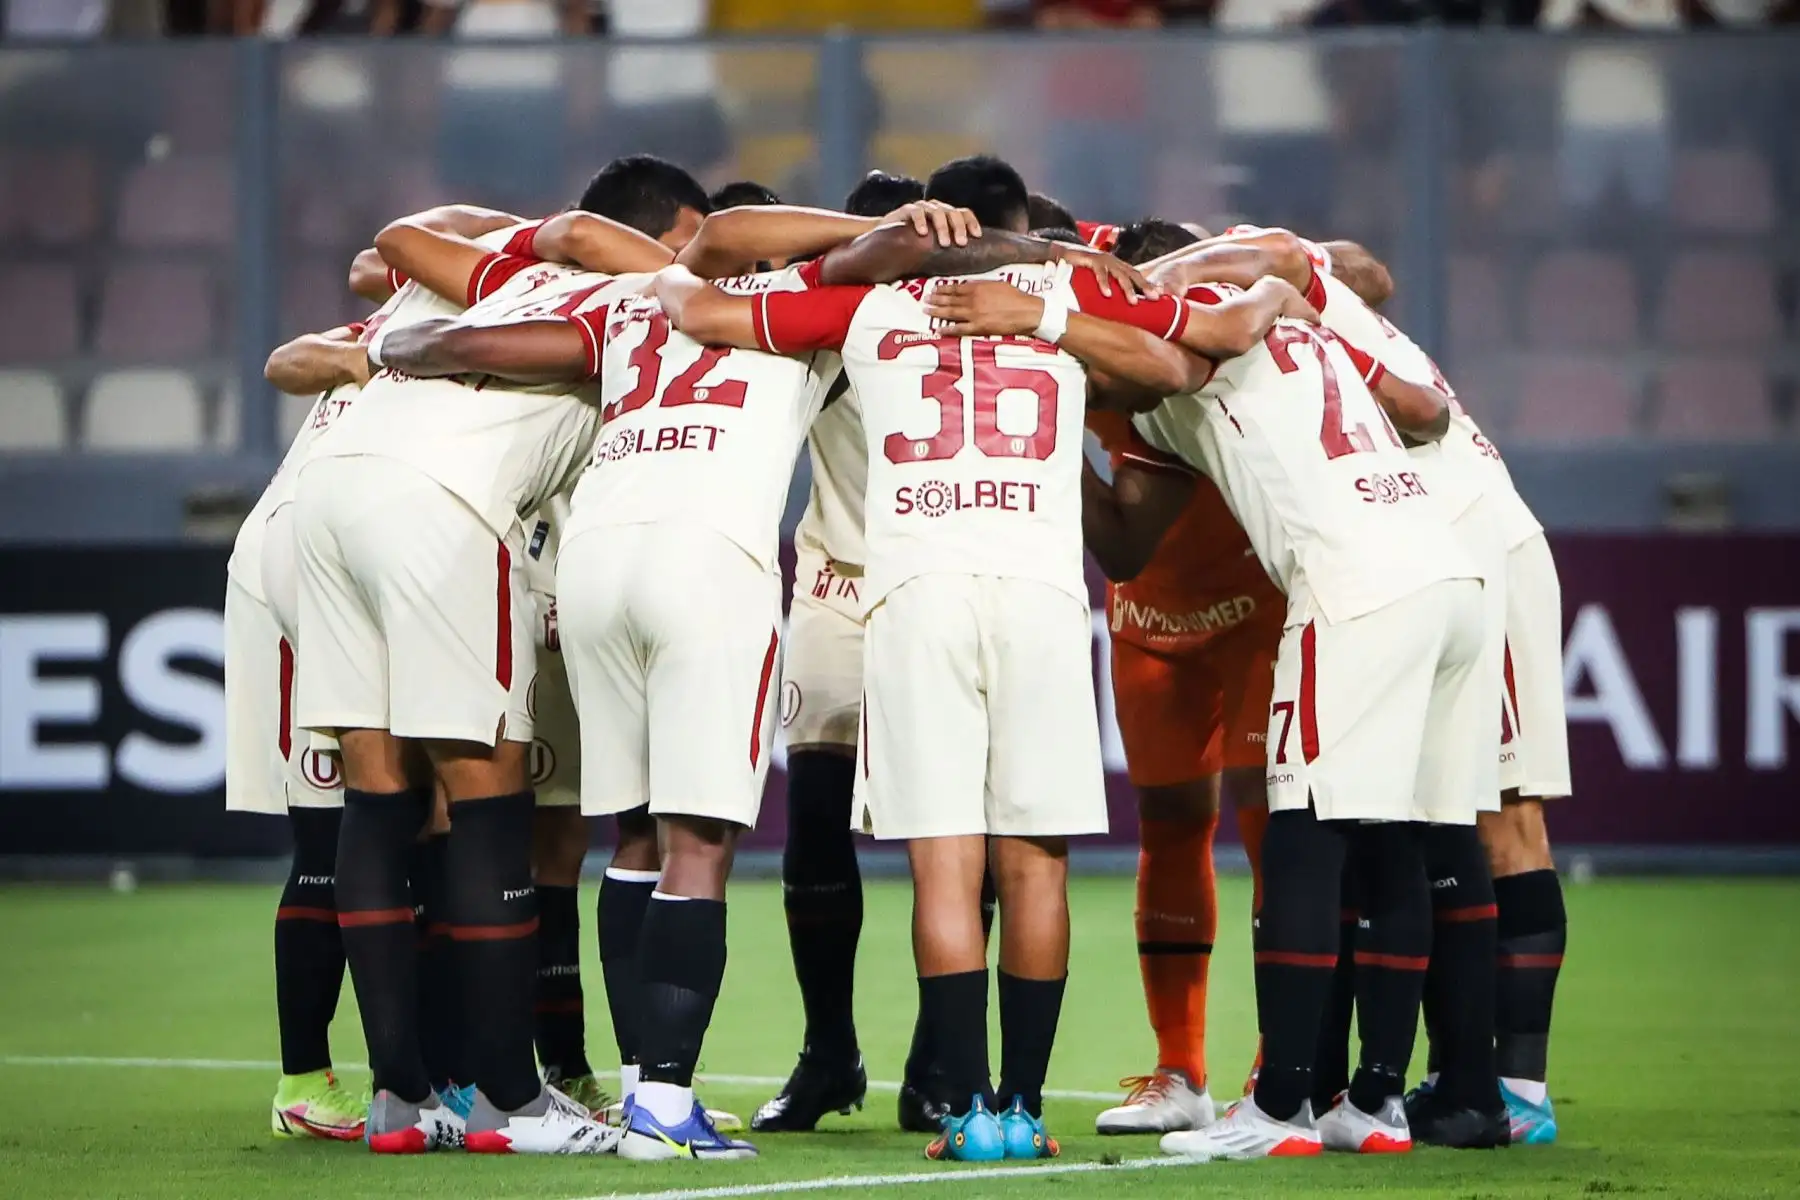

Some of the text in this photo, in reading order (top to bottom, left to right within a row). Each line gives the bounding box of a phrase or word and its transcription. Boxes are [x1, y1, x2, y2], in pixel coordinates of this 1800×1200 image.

[602, 307, 748, 425] 32
[877, 329, 1058, 465] 36
[1263, 324, 1402, 460] 2
[596, 425, 725, 466] SOLBET
[895, 479, 1041, 518] SOLBET
[0, 606, 228, 793] ES
[1272, 701, 1294, 764] 7
